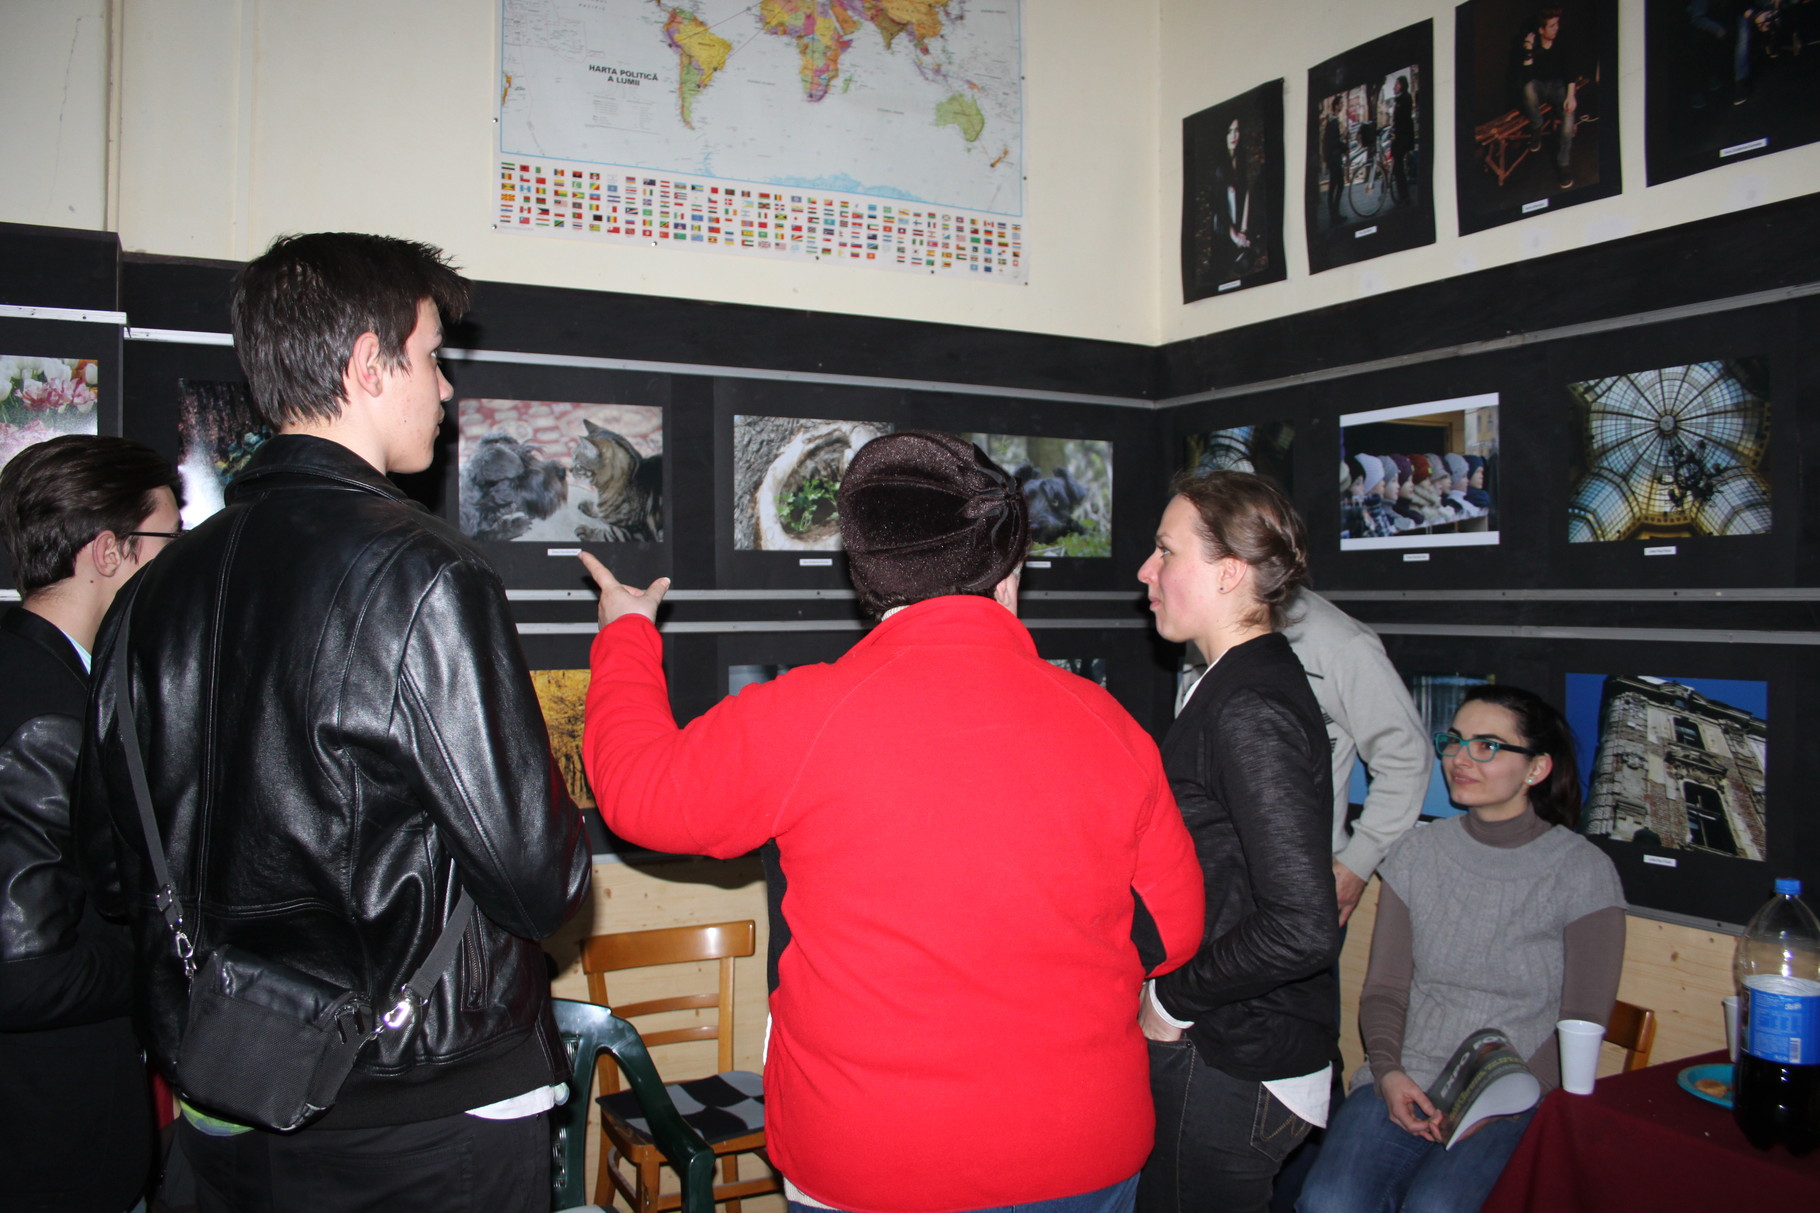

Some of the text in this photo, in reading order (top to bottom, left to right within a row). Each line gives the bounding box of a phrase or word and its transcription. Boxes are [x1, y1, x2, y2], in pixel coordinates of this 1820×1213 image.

[589, 64, 658, 81] HARTA POLITICĂ
[616, 77, 640, 86] LUMII
[1440, 1052, 1471, 1098] EXPO
